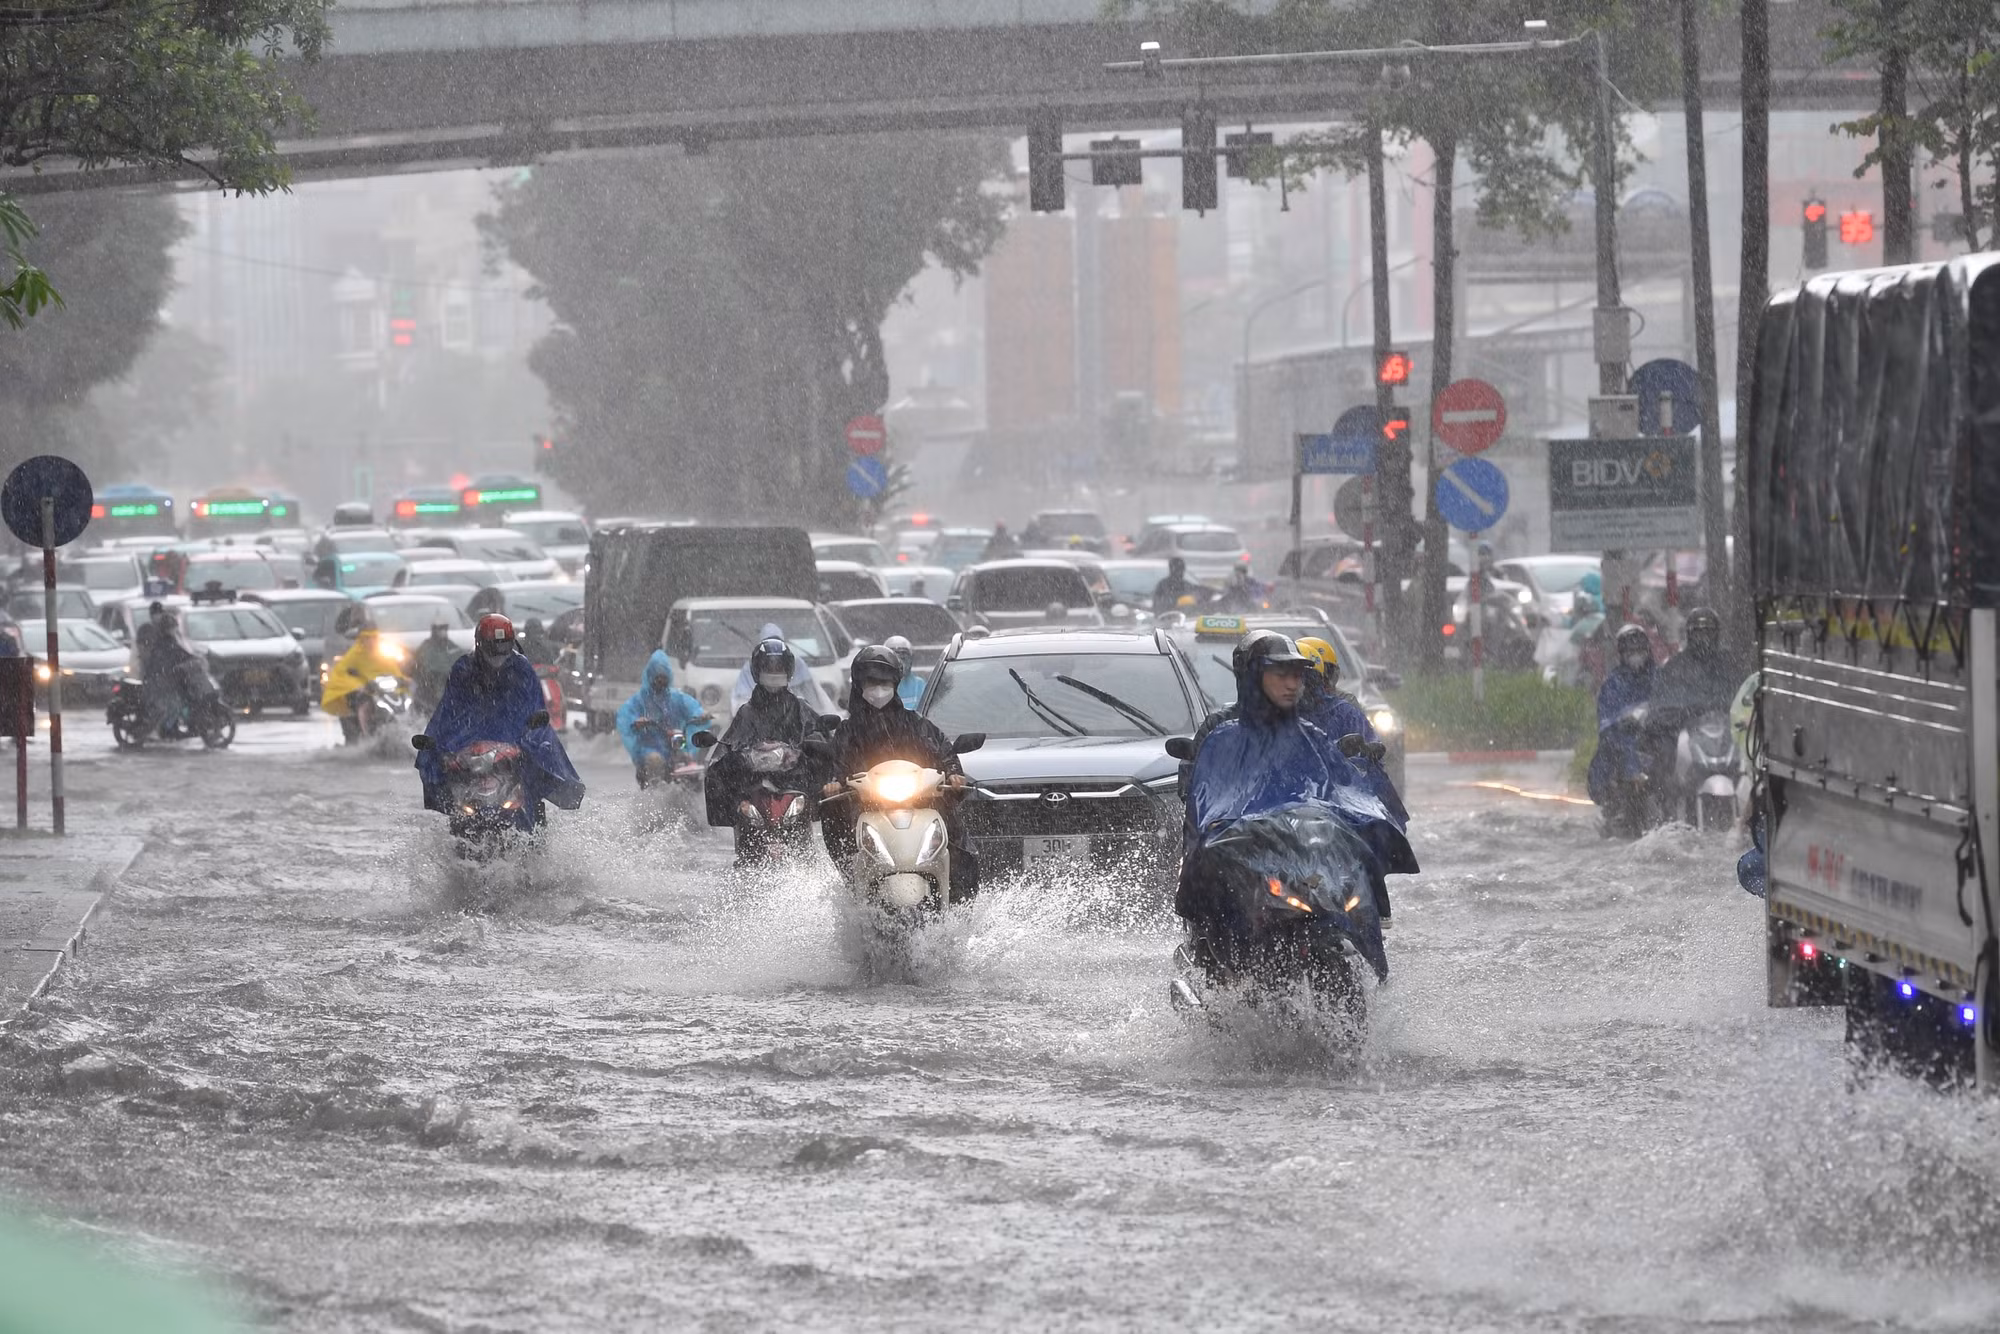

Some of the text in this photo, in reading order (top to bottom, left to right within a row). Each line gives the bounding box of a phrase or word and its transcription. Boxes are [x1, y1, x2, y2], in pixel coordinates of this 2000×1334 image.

[1571, 459, 1643, 487] BIDV
[1206, 618, 1237, 628] Grab
[1042, 839, 1071, 853] 30H
